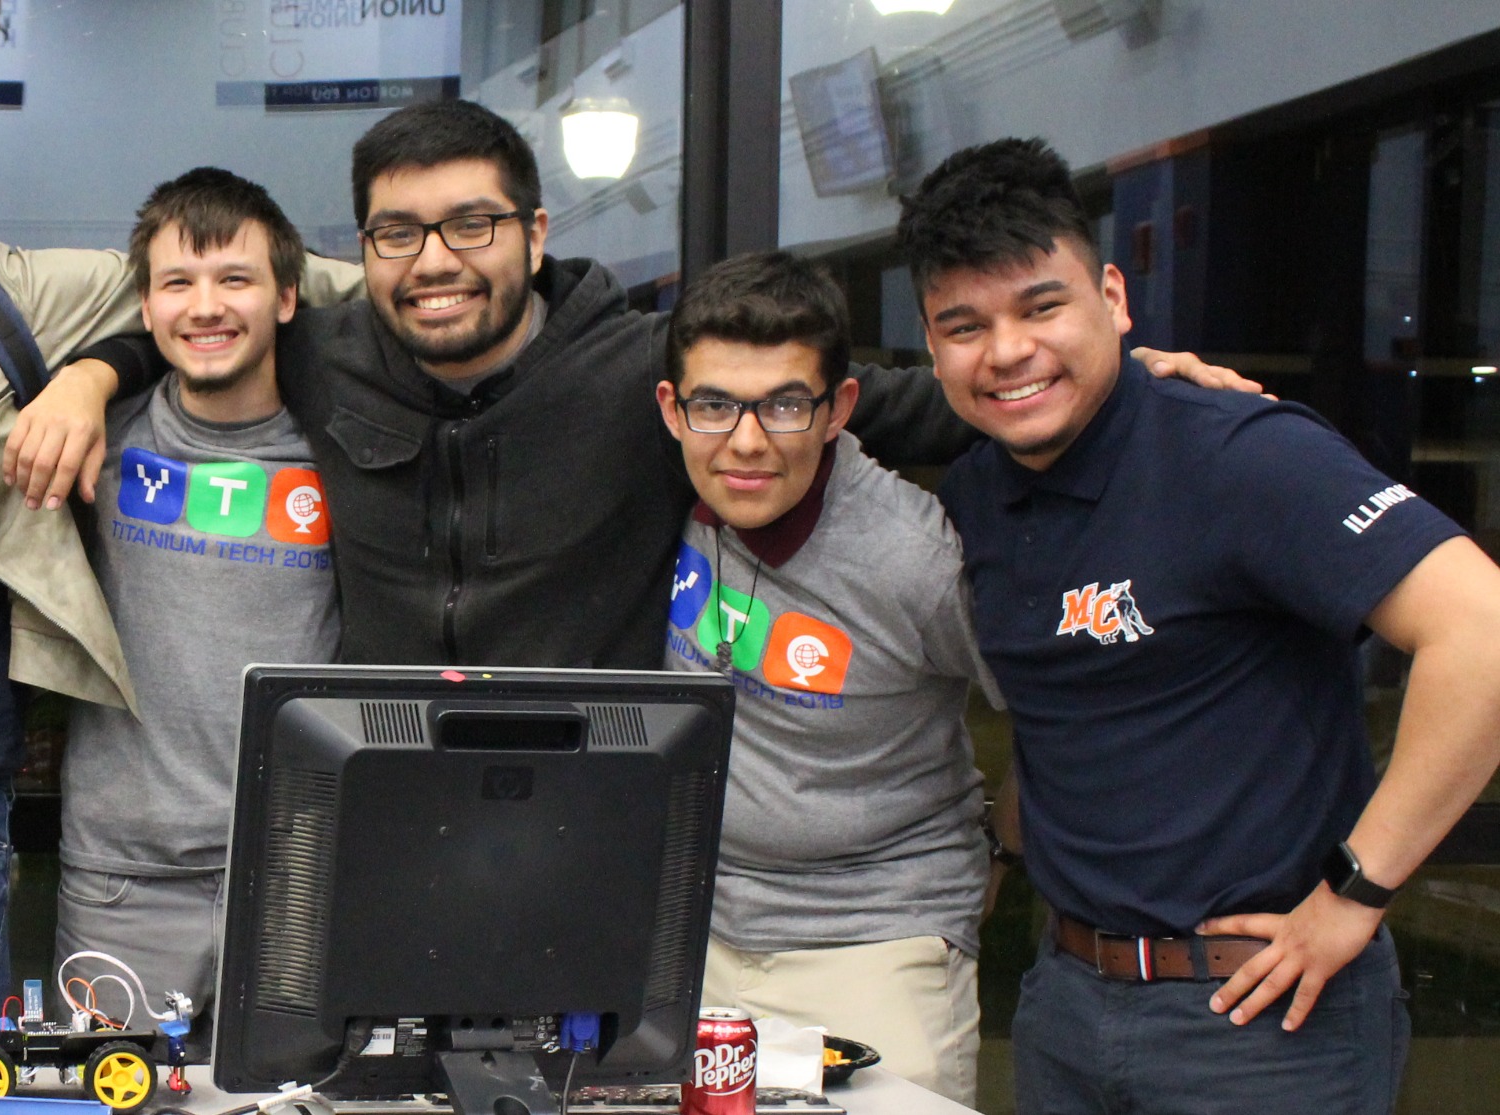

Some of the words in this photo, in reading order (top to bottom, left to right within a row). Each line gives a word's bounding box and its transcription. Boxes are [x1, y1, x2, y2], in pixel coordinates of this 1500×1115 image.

[112, 519, 206, 556] TITANIUM
[216, 541, 275, 566] TECH
[693, 1048, 756, 1090] Pepper
[714, 1043, 745, 1069] Dr
